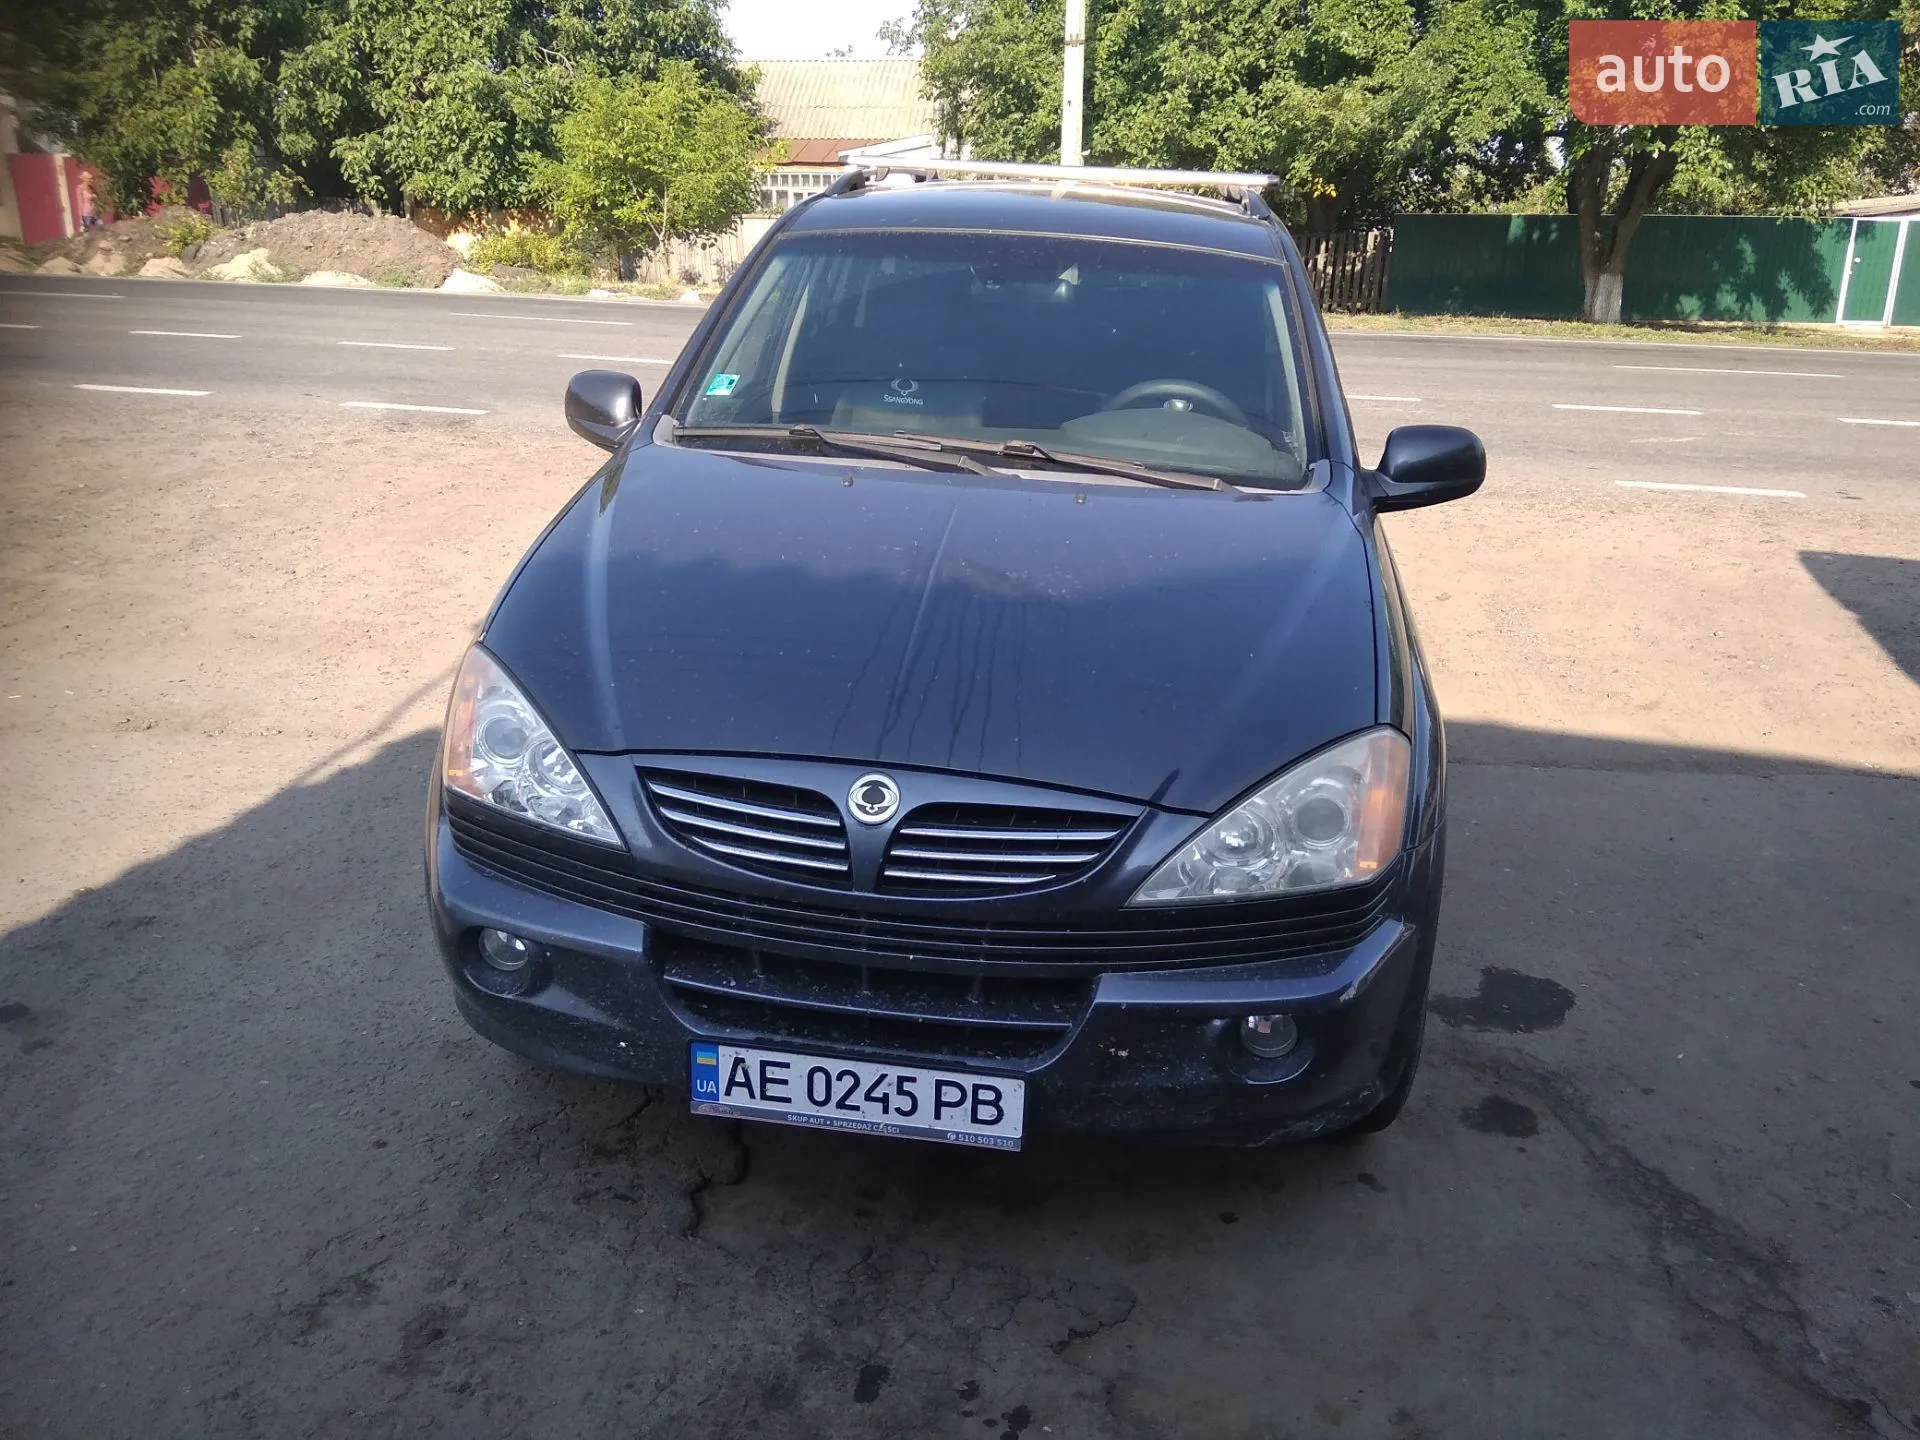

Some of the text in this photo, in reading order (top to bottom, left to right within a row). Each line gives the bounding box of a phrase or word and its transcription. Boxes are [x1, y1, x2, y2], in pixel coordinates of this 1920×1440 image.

[697, 1080, 717, 1094] UA
[724, 1056, 1005, 1126] AE 0245 PB
[787, 1114, 808, 1123] SKUP
[809, 1117, 824, 1125] AUT
[959, 1134, 1014, 1147] 510 503 510
